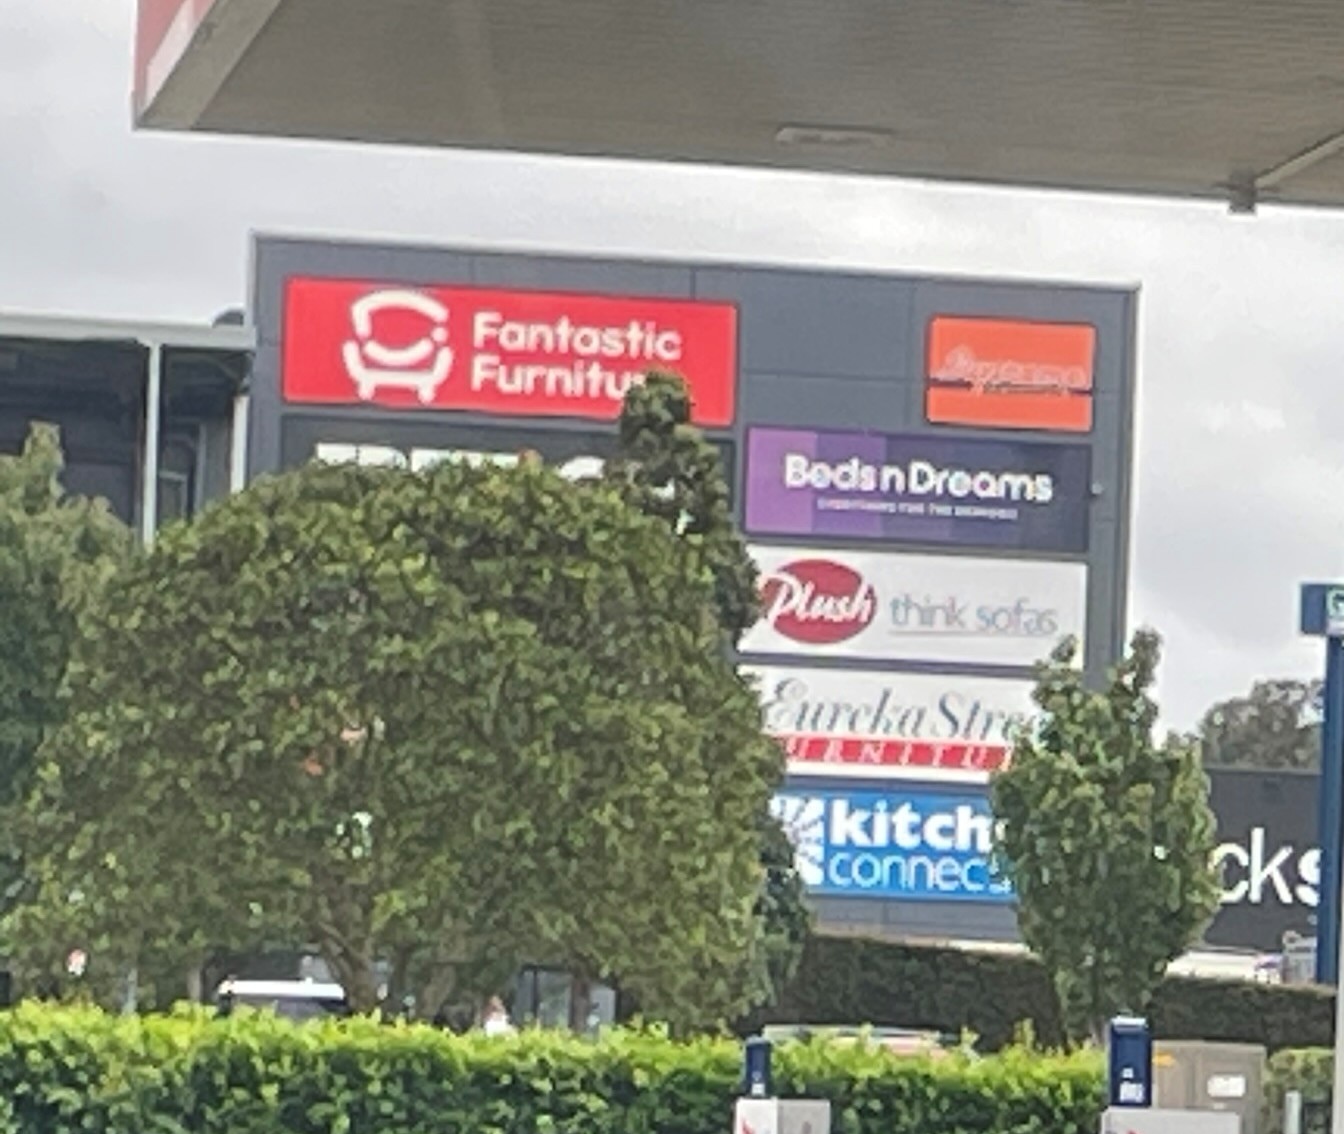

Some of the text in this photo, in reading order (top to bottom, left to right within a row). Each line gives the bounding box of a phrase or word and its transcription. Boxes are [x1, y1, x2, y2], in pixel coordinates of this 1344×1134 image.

[472, 310, 682, 361] Fantastic
[470, 353, 647, 400] Furnitu
[784, 453, 876, 491] Beds
[908, 461, 1054, 502] Dreams
[757, 571, 875, 625] Plush
[889, 595, 1058, 634] think sofas
[761, 677, 927, 734] Eureka
[829, 797, 1010, 851] kitch
[828, 851, 990, 892] connec
[1207, 827, 1321, 906] cks
